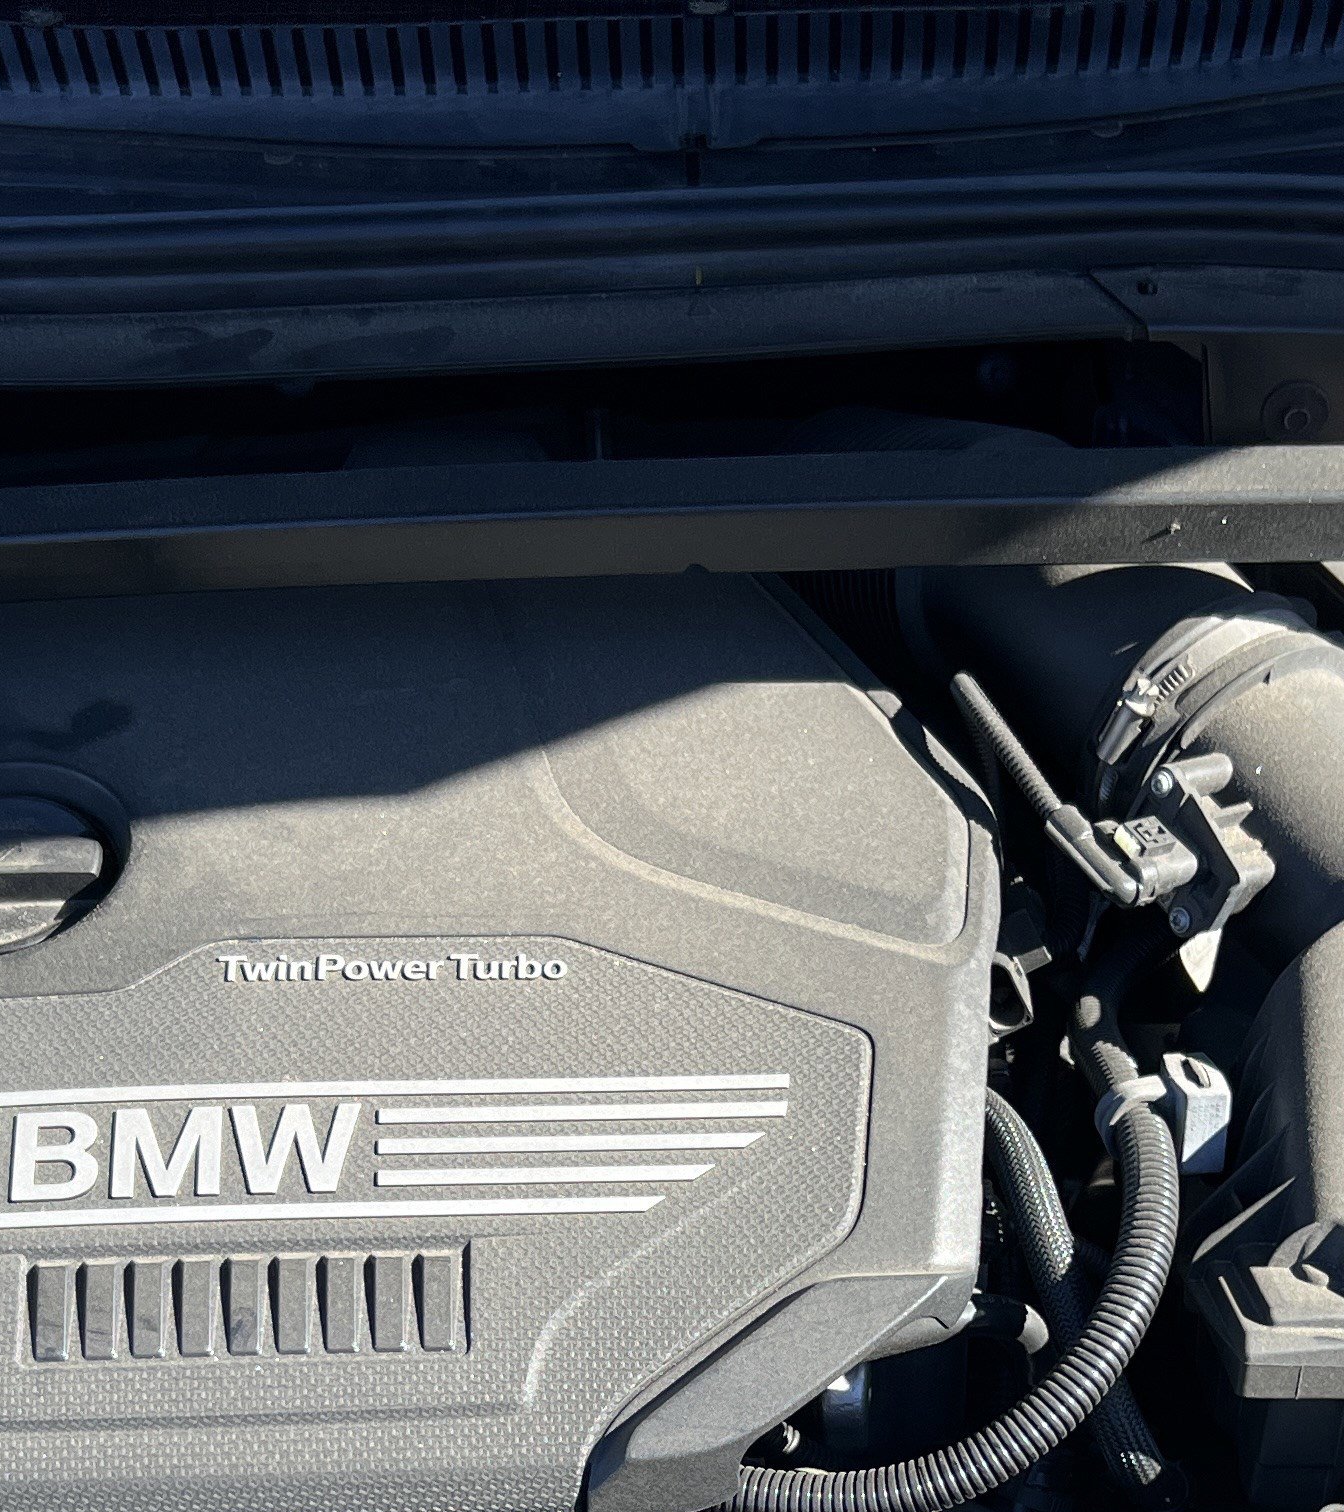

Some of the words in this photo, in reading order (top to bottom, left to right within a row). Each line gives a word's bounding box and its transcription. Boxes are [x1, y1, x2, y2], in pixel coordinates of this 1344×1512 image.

[217, 954, 444, 982] TwinPower
[448, 953, 568, 981] Turbo
[8, 1102, 362, 1204] BMW
